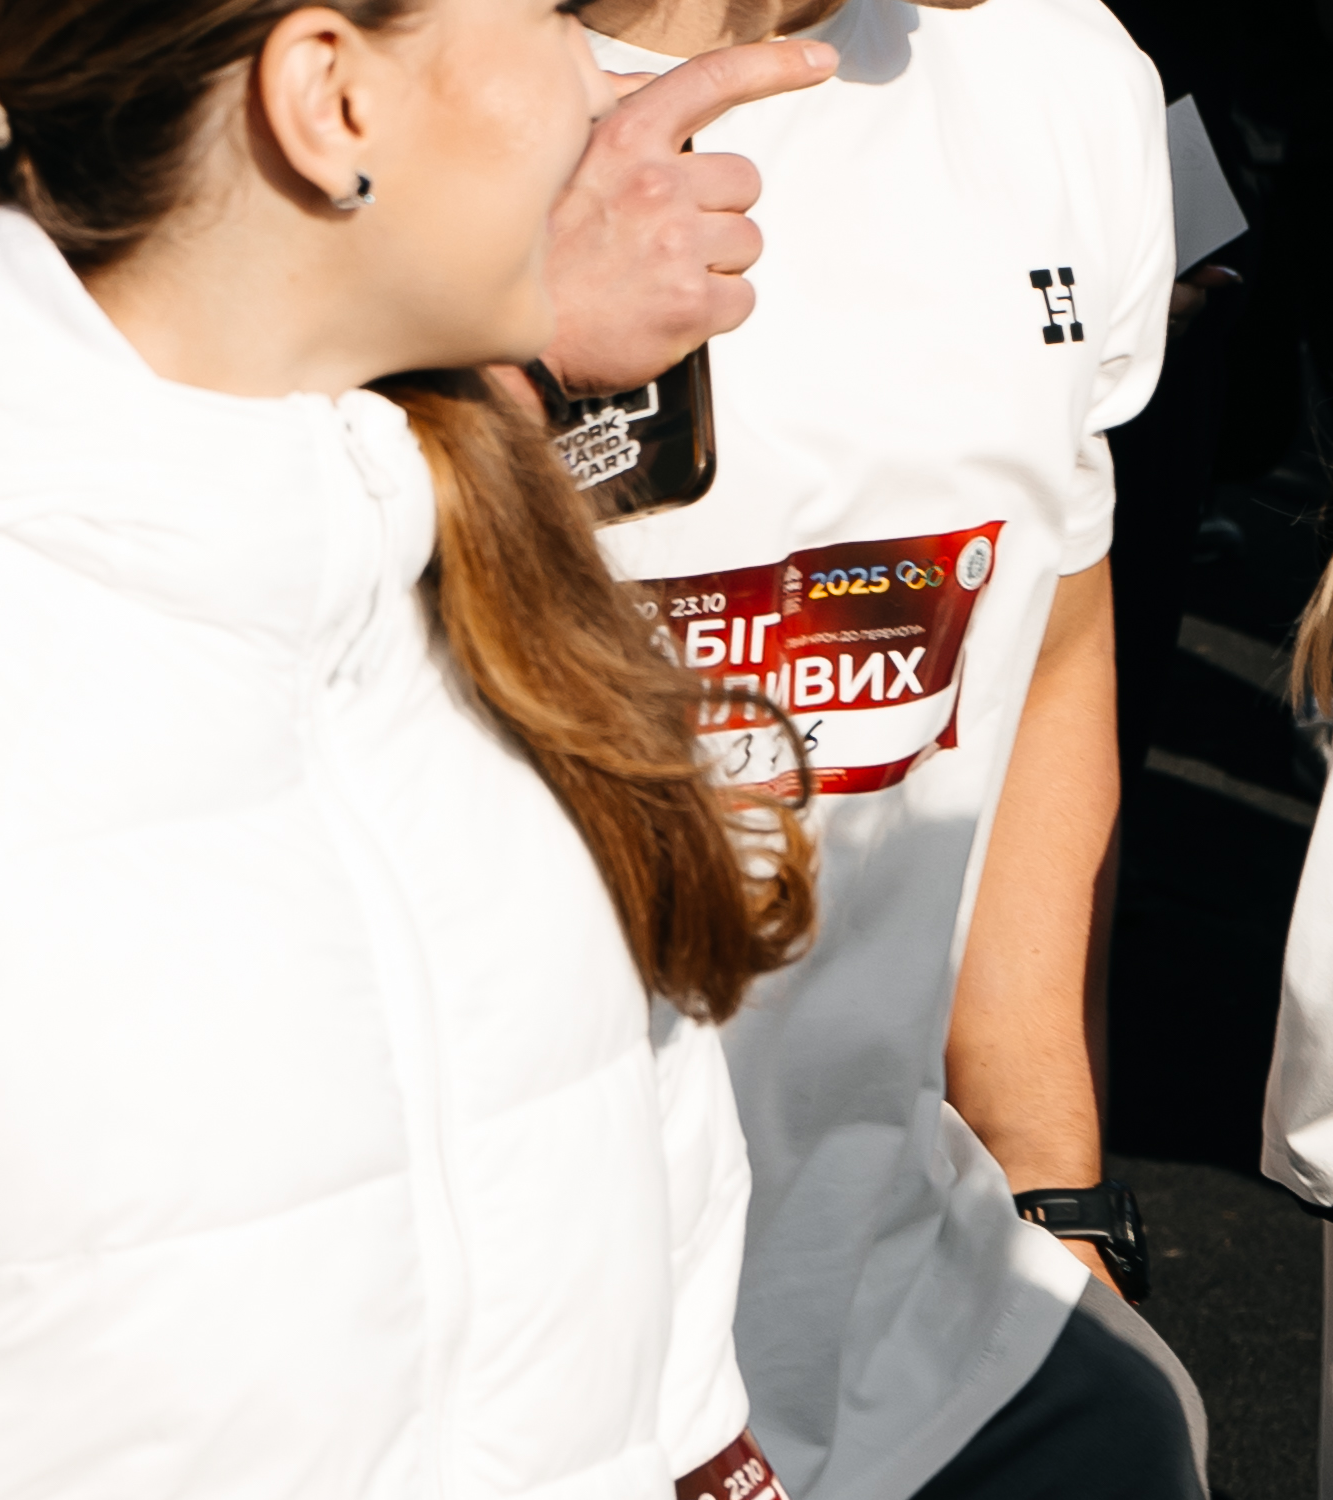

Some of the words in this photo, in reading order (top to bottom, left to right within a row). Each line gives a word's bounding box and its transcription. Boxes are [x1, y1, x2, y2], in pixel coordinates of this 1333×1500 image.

[564, 434, 621, 469] ARD
[809, 567, 890, 600] 2025
[669, 593, 726, 618] 23.10
